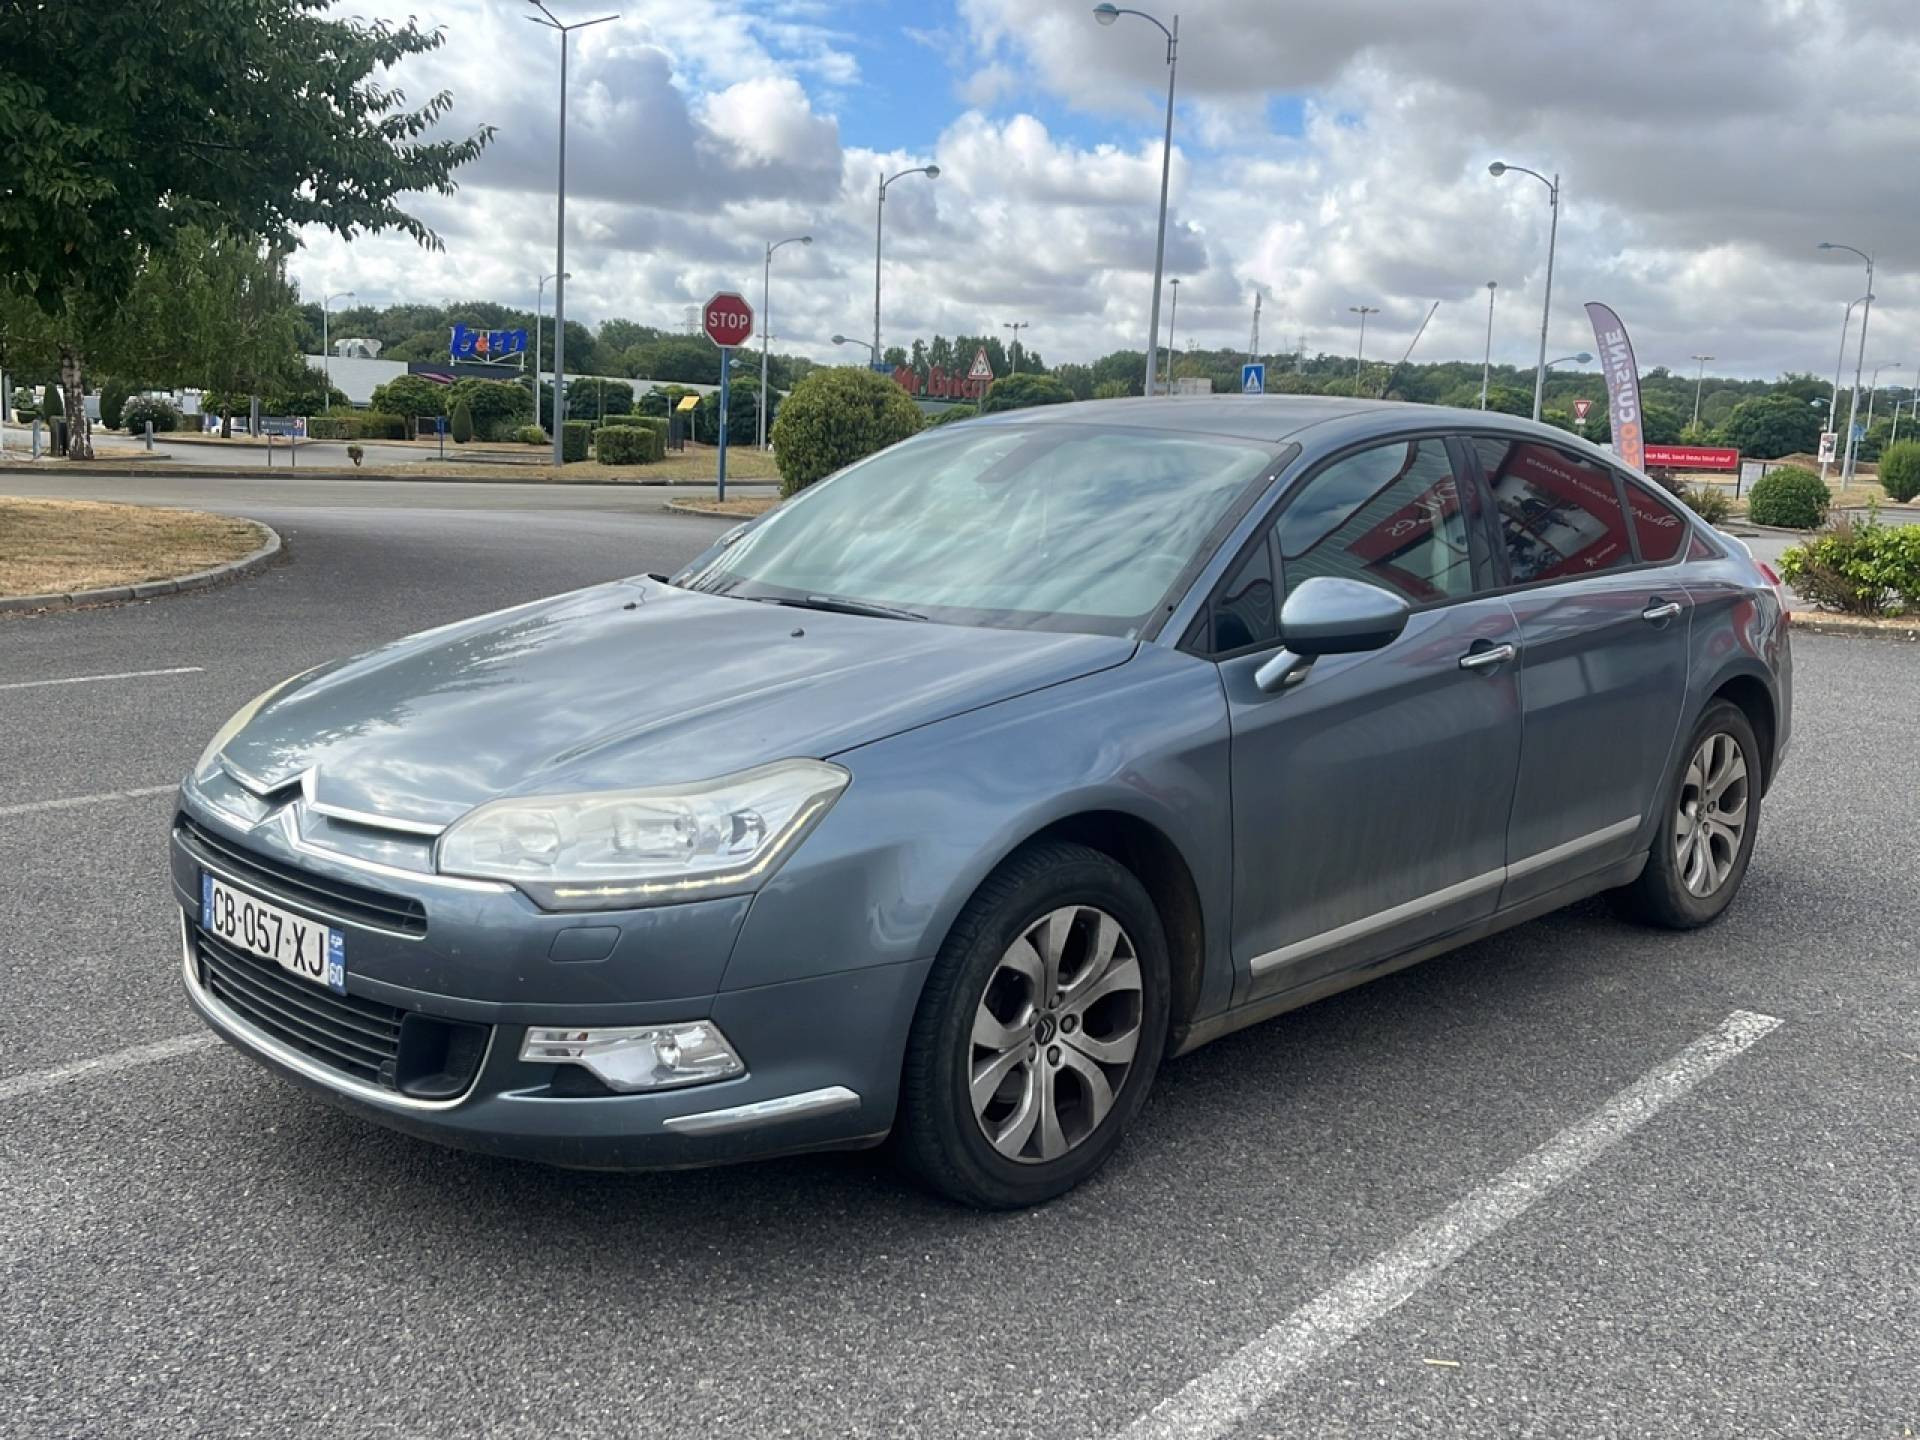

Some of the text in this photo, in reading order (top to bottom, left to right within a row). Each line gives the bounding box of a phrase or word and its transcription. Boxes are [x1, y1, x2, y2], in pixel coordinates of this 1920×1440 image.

[709, 311, 748, 329] STOP
[452, 322, 528, 357] b&m
[214, 887, 324, 977] CB-057-XJ
[330, 962, 344, 987] 60
